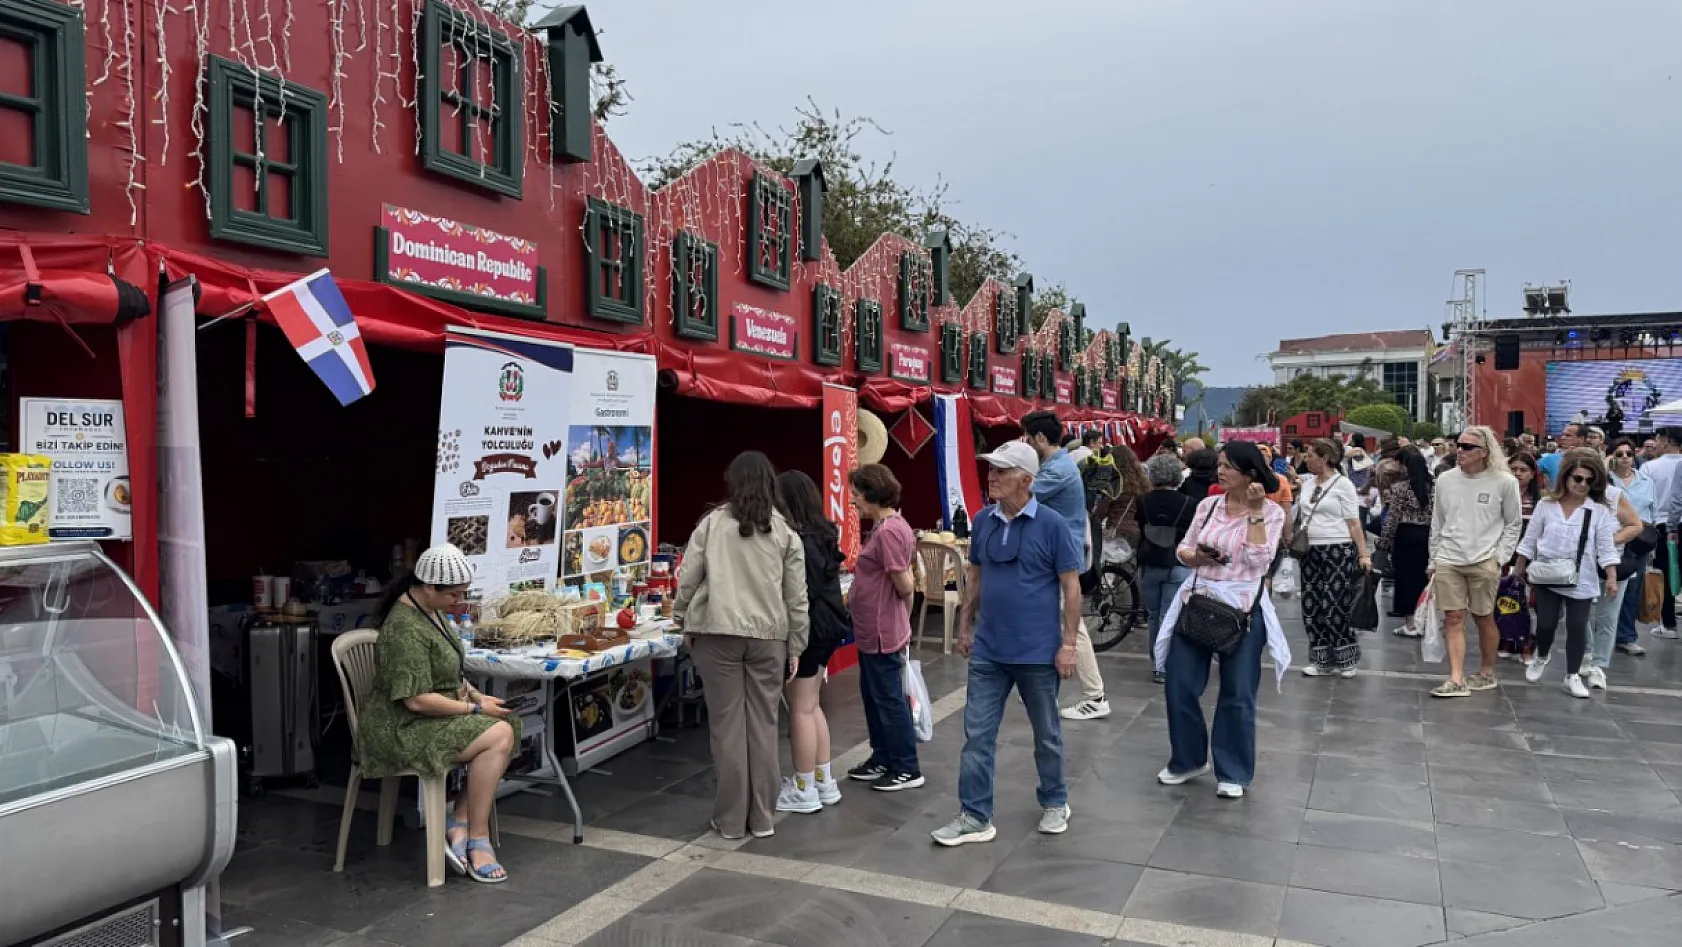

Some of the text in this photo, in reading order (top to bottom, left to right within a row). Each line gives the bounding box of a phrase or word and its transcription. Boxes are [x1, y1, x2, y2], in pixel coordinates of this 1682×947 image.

[393, 231, 533, 282] Dominican Republic
[745, 318, 787, 345] Venezuela
[47, 412, 113, 427] DEL SUR
[484, 425, 533, 436] KAHVE'NİN
[36, 439, 58, 450] BİZİ
[61, 439, 94, 450] TAKİP
[481, 439, 534, 450] YOLCULUĞU
[53, 461, 115, 469] OLLOW US!
